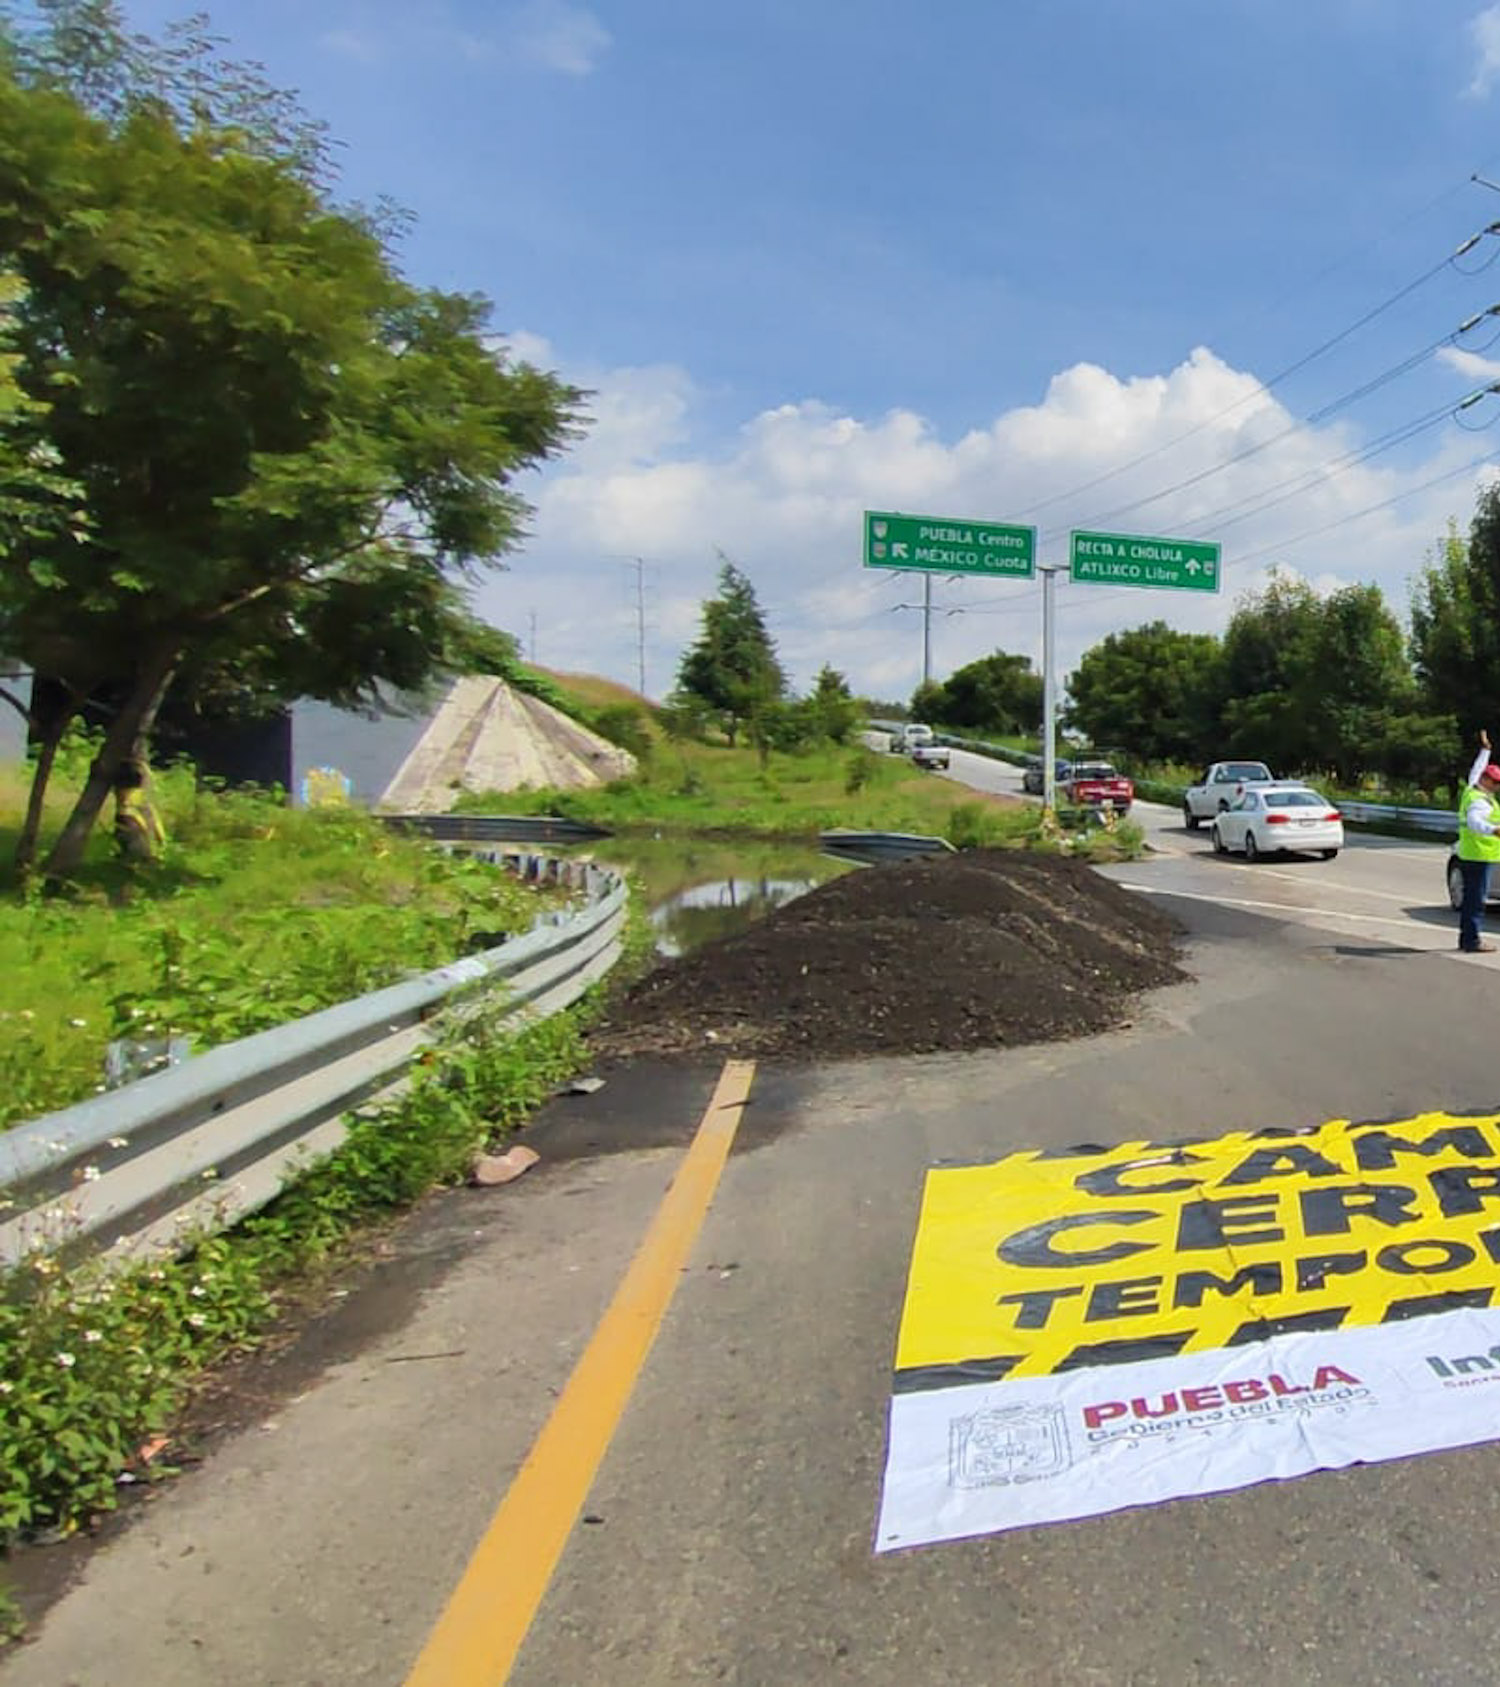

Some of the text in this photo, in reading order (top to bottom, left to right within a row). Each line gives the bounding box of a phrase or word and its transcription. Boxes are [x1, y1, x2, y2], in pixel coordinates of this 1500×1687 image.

[919, 526, 1024, 548] PUEBLA Centro
[915, 545, 1028, 570] MÉXICO Cuota
[1077, 540, 1183, 561] RECTA A CHOLULA
[1080, 562, 1179, 581] ATLIXCO Libre
[1082, 1365, 1363, 1429] PUEBLA
[1087, 1411, 1224, 1443] Gobierno
[1230, 1400, 1271, 1420] del
[1279, 1387, 1371, 1410] Estado
